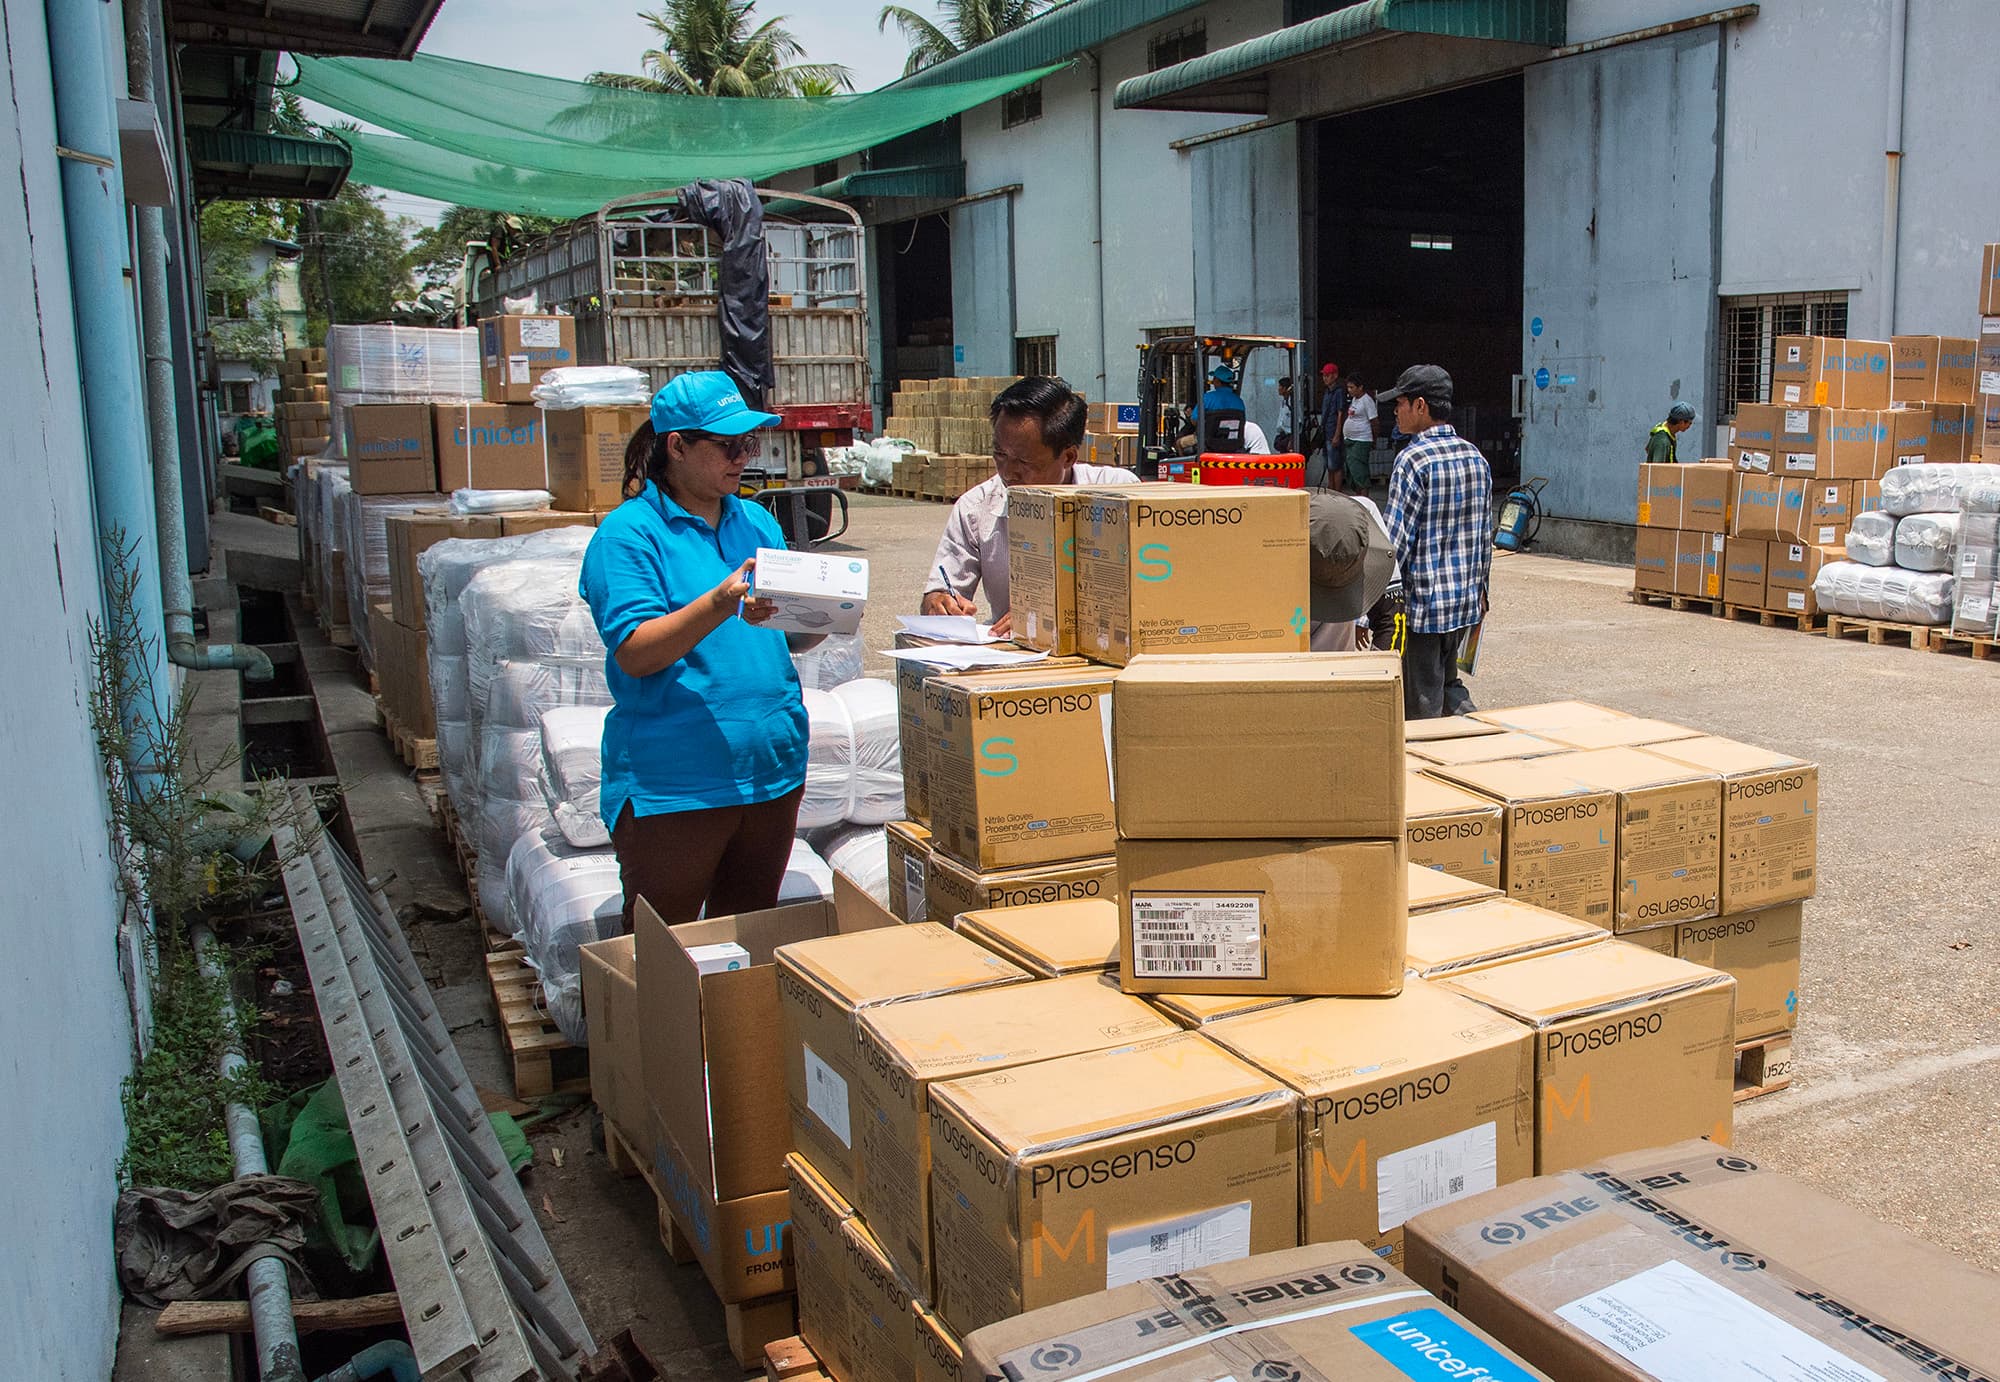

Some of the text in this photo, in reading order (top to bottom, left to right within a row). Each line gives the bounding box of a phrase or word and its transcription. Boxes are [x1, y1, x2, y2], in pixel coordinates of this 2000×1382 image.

[453, 419, 537, 446] unicef
[807, 479, 837, 488] STOP
[1009, 496, 1045, 520] Prosenso
[1076, 501, 1118, 525] Prosenso
[1137, 504, 1243, 528] Prosenso
[1136, 543, 1173, 582] S
[1139, 628, 1176, 637] Prosenso
[1160, 618, 1185, 627] Gloves
[978, 693, 1093, 721] Prosenso
[979, 737, 1019, 777] S
[1729, 775, 1804, 801] Prosenso
[1007, 813, 1034, 823] Gloves
[1513, 802, 1598, 828] Prosenso
[1804, 800, 1813, 815] L
[985, 822, 1024, 834] Prosenso
[1407, 821, 1483, 843] rosenso
[1600, 828, 1609, 844] L
[1483, 848, 1493, 865] L
[1514, 846, 1544, 856] Prosenso
[930, 870, 973, 906] Prosenso
[989, 879, 1100, 909] Prosenso
[1637, 891, 1716, 920] Prosenso
[1682, 918, 1756, 946] Prosenso
[1547, 1012, 1663, 1062] Prosenso
[857, 1027, 905, 1099] Prosenso
[1314, 1072, 1450, 1130] Prosenso
[1546, 1072, 1591, 1133] M
[930, 1098, 997, 1185] Prosenso
[1031, 1139, 1196, 1199] Prosenso
[1313, 1138, 1367, 1205] M
[1032, 1206, 1096, 1279] M
[746, 1258, 783, 1277] FROM
[844, 1236, 907, 1312] Prosenso
[914, 1316, 962, 1382] Prosen
[1387, 1320, 1489, 1379] unicef
